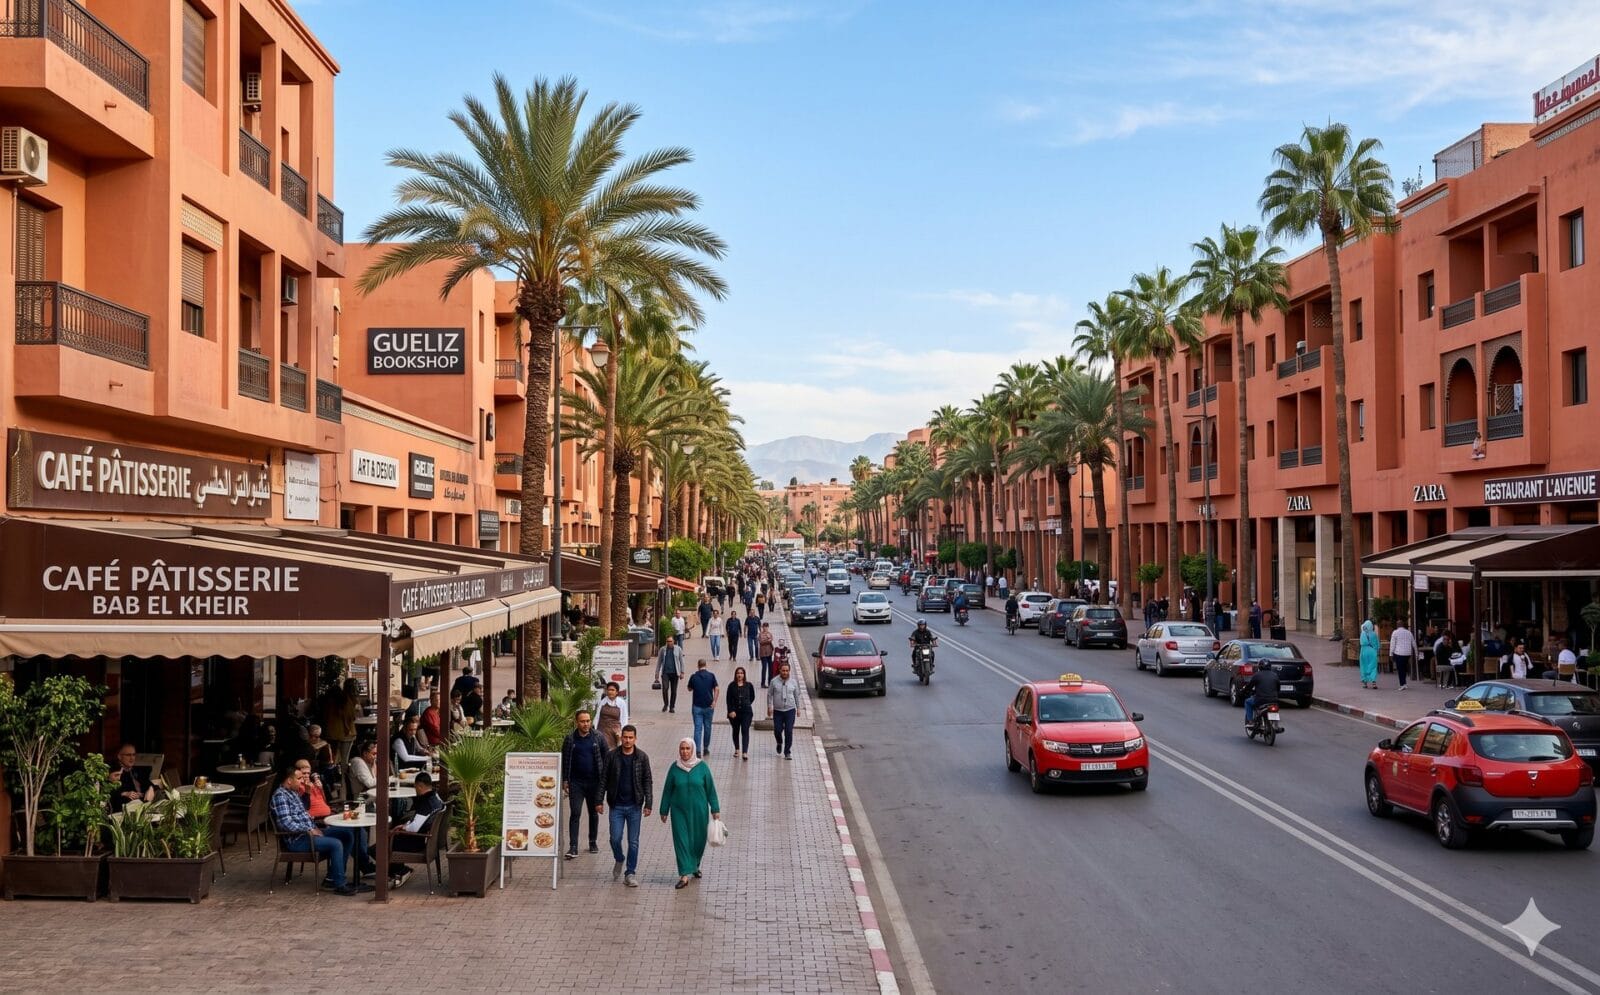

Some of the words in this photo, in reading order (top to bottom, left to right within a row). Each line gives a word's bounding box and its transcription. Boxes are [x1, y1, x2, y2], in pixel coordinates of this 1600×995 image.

[373, 333, 459, 352] GUELIZ
[373, 355, 459, 369] BOOKSHOP
[38, 446, 93, 492] CAFÉ
[99, 449, 192, 499] PÂTISSERIE
[357, 457, 370, 476] ART
[376, 461, 396, 480] DESIGN
[1413, 484, 1447, 502] ZARA
[1484, 480, 1543, 500] RESTAURANT
[1546, 475, 1596, 497] L'AVENUE
[1286, 495, 1311, 511] ZARA
[42, 559, 121, 592] CAFÉ
[131, 559, 300, 592] PÂTISSERIE
[93, 596, 140, 615] BAB
[148, 596, 173, 615] EL
[180, 596, 249, 615] KHEIR
[401, 581, 418, 613] CAFÉ
[419, 580, 453, 609] PÂTISSERIE
[453, 581, 465, 602] BAB
[465, 580, 471, 600] EL
[471, 578, 486, 599] KHEIR
